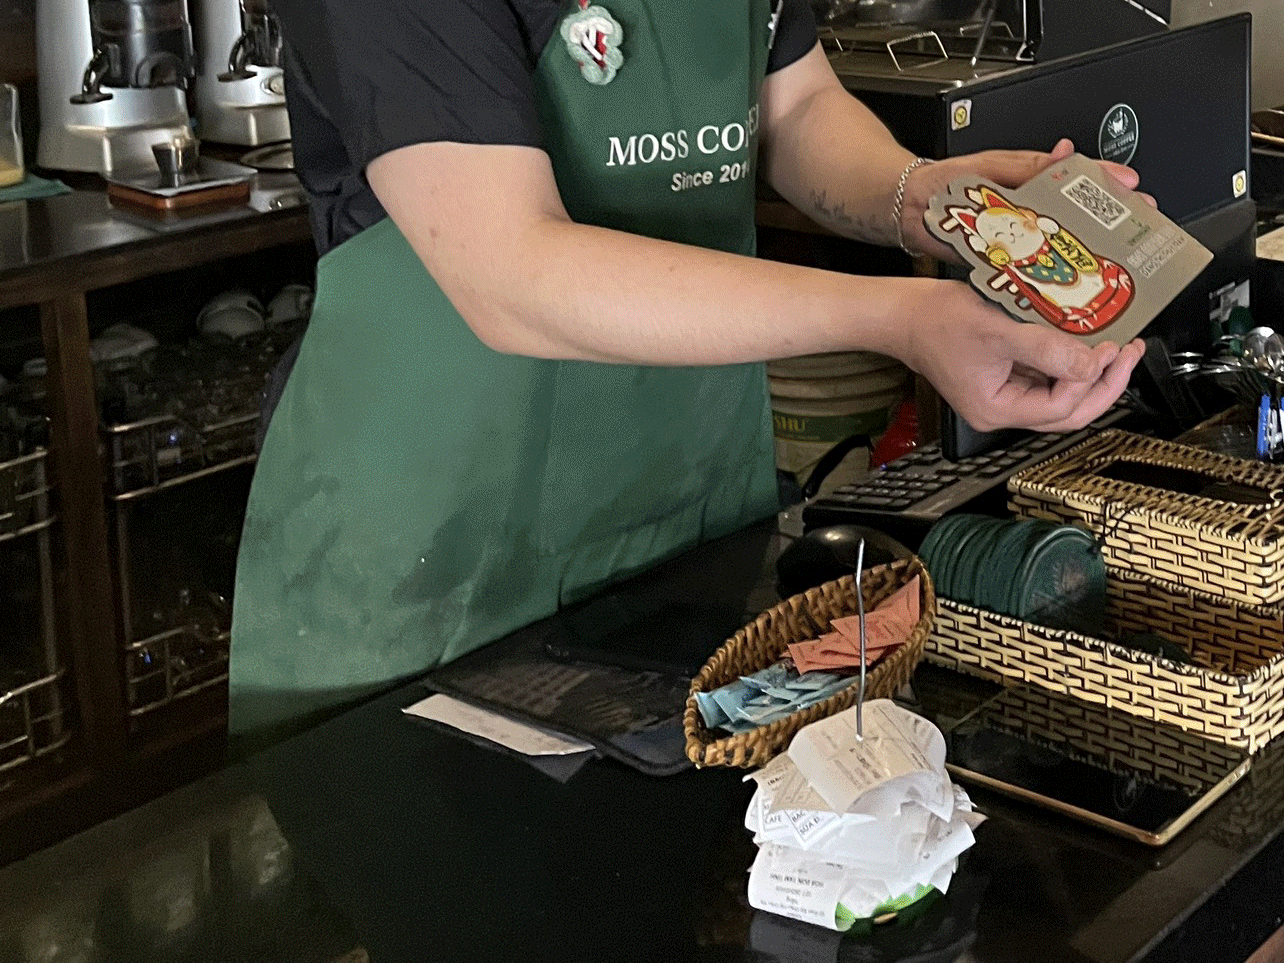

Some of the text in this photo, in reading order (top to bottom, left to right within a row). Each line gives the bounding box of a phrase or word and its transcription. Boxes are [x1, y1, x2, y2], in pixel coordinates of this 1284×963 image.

[605, 129, 690, 167] MOSS
[670, 158, 751, 192] Since 201
